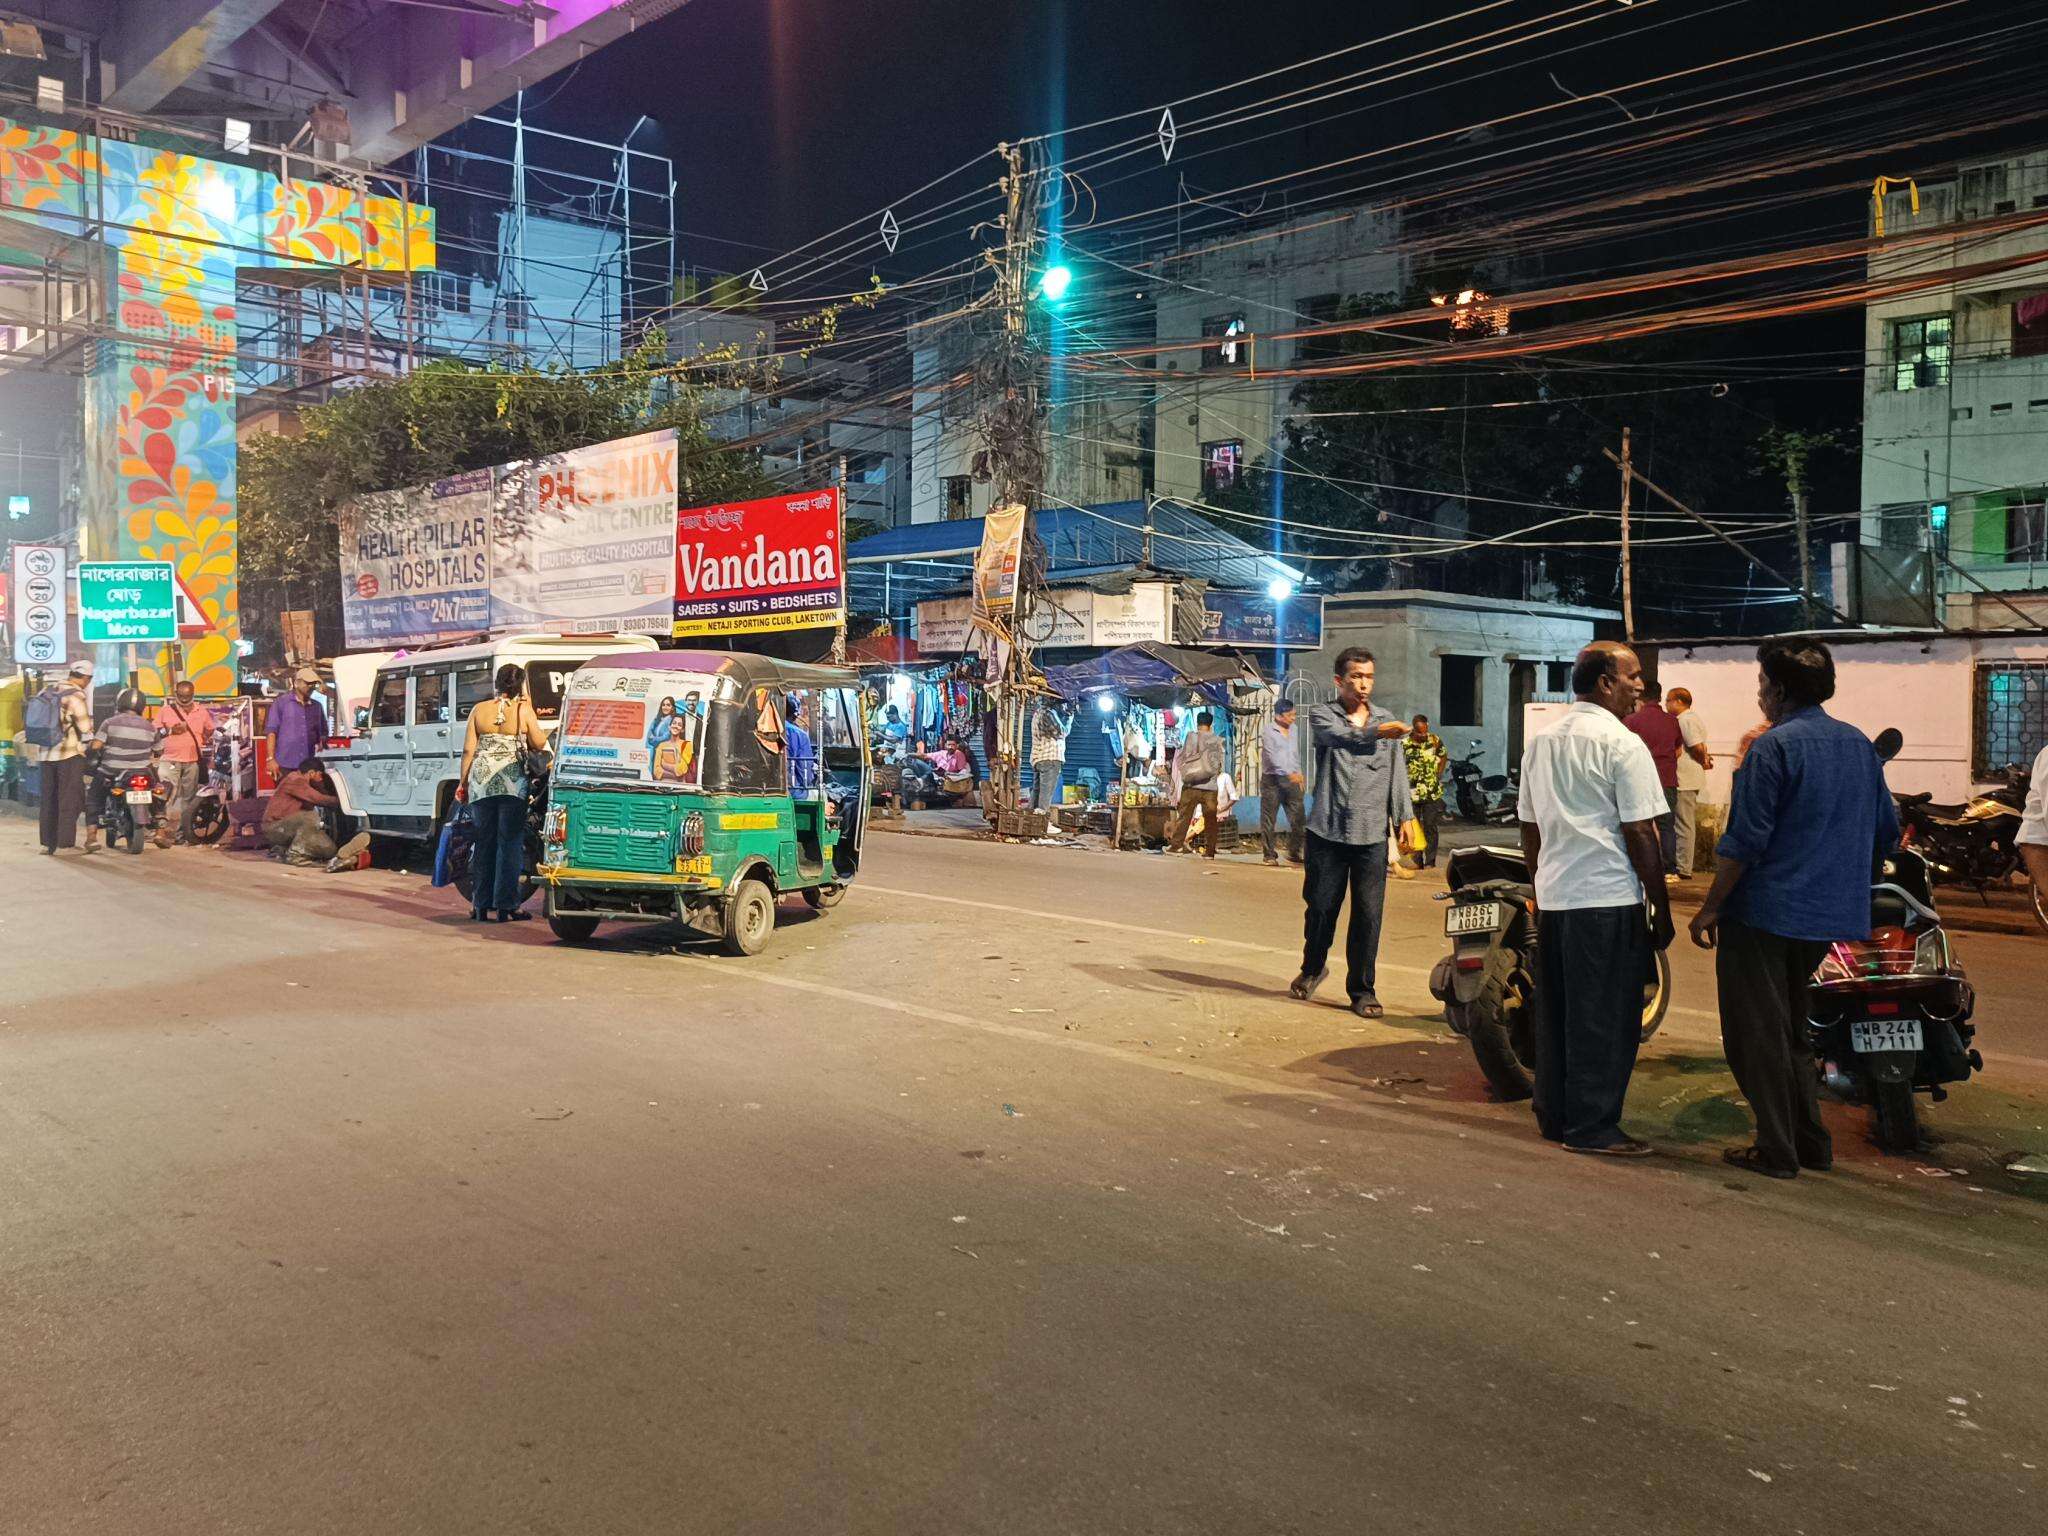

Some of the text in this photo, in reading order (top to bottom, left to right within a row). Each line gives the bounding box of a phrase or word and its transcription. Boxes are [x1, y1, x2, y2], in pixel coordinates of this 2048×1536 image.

[610, 501, 673, 531] CENTRE
[358, 517, 486, 561] HEALTH PILLAR
[540, 540, 670, 569] MULTI-SPECIALITY HOSPITAL
[679, 533, 836, 594] Vandana
[34, 564, 48, 573] 30
[81, 567, 171, 583] নাগেরবাজার
[390, 553, 486, 591] HOSPITALS
[34, 593, 48, 602] 20
[106, 588, 144, 605] মোড়
[677, 591, 838, 617] SAREES SUITS BEDSHEETS
[81, 605, 174, 623] Nagerbazar
[430, 596, 461, 624] 24x7
[106, 623, 149, 636] More
[707, 621, 733, 631] NETAJI
[733, 617, 770, 629] SPORTING
[771, 615, 794, 626] CLUB,
[795, 611, 838, 624] LAKETOWN
[34, 650, 48, 658] 20
[1861, 1021, 1915, 1036] WB 24A
